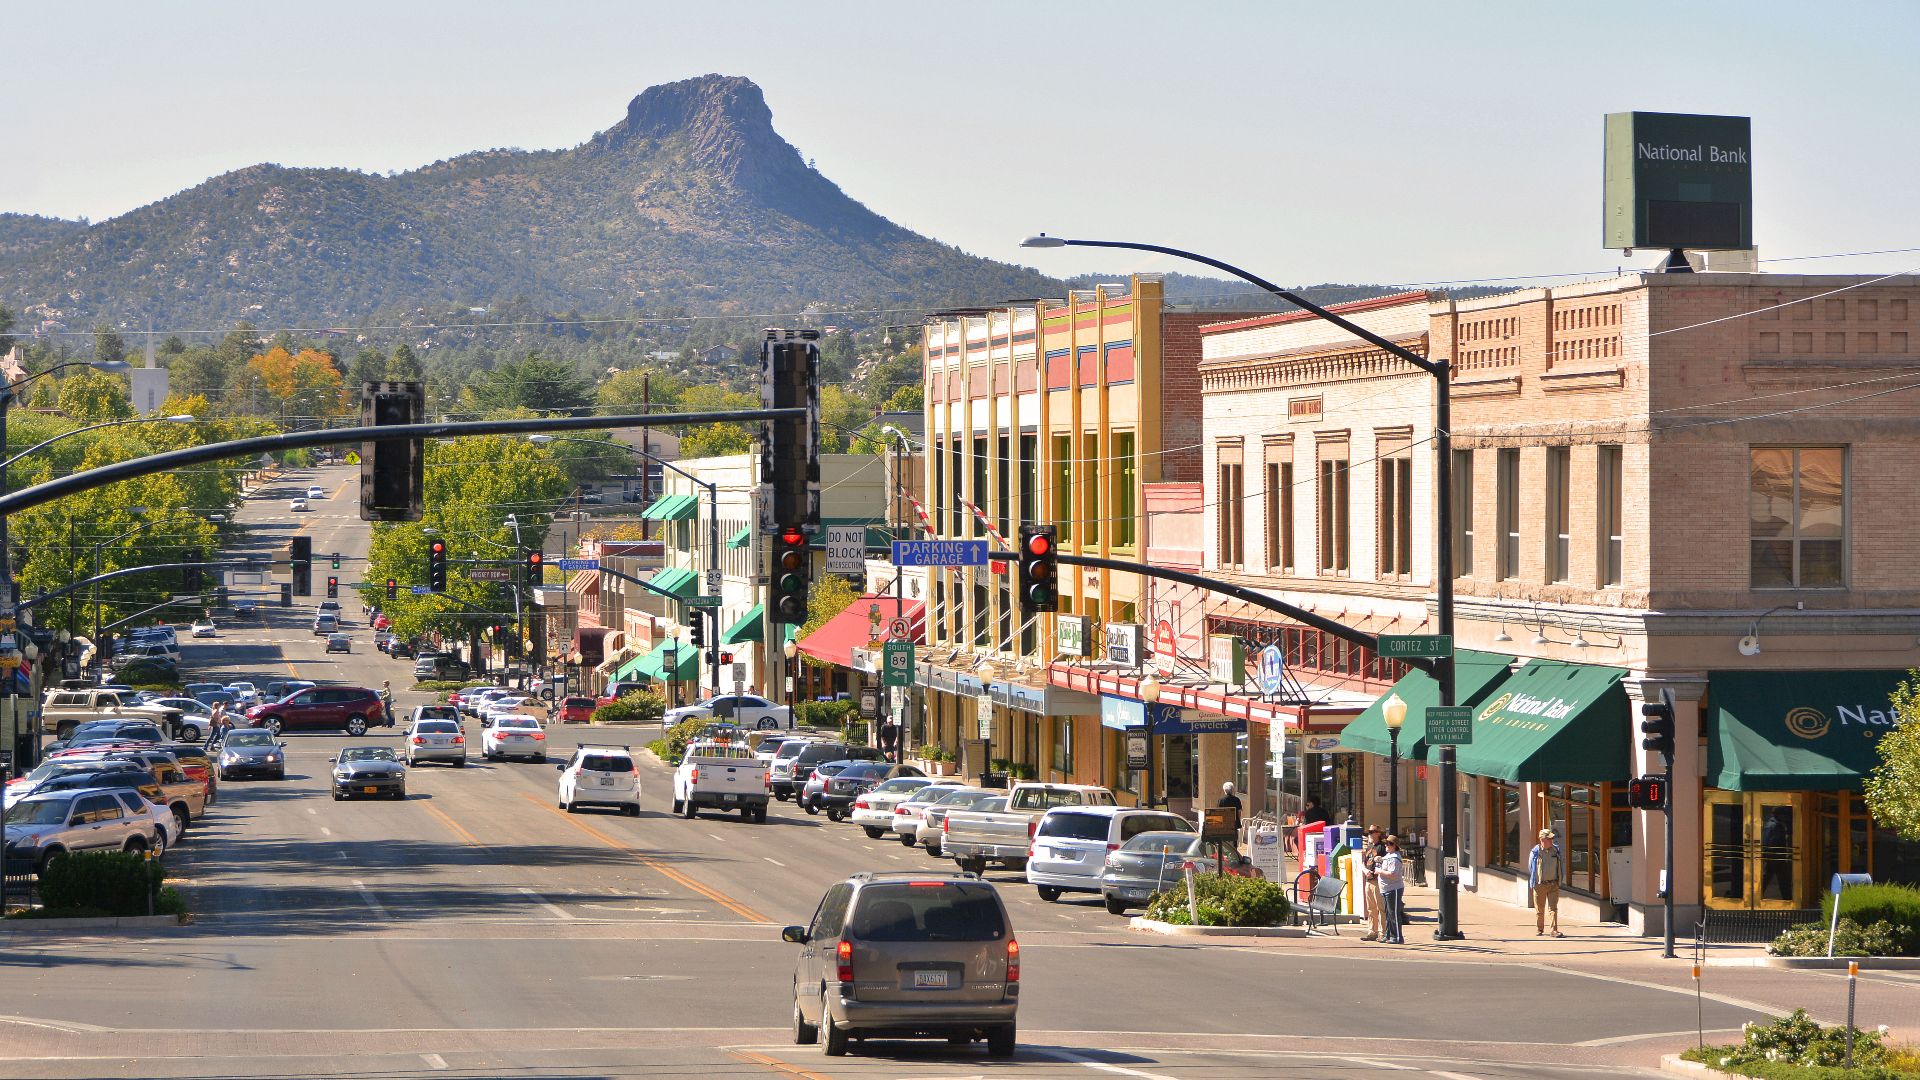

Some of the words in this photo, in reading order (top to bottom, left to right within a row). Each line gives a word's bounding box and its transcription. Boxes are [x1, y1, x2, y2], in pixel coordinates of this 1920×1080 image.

[1638, 142, 1702, 161] National
[1710, 146, 1747, 164] Bank
[828, 532, 841, 543] DO
[845, 532, 863, 543] NOT
[828, 547, 862, 558] BLOCK
[900, 542, 964, 564] PARKING
[915, 553, 964, 564] GARAGE
[827, 561, 863, 569] INTERSECTION
[708, 573, 721, 582] 89
[1390, 640, 1421, 651] CORTEZ
[1429, 640, 1440, 651] ST
[892, 655, 906, 666] 89
[1502, 692, 1556, 716] National
[1541, 698, 1578, 719] Bank
[1189, 721, 1229, 731] Jewelers
